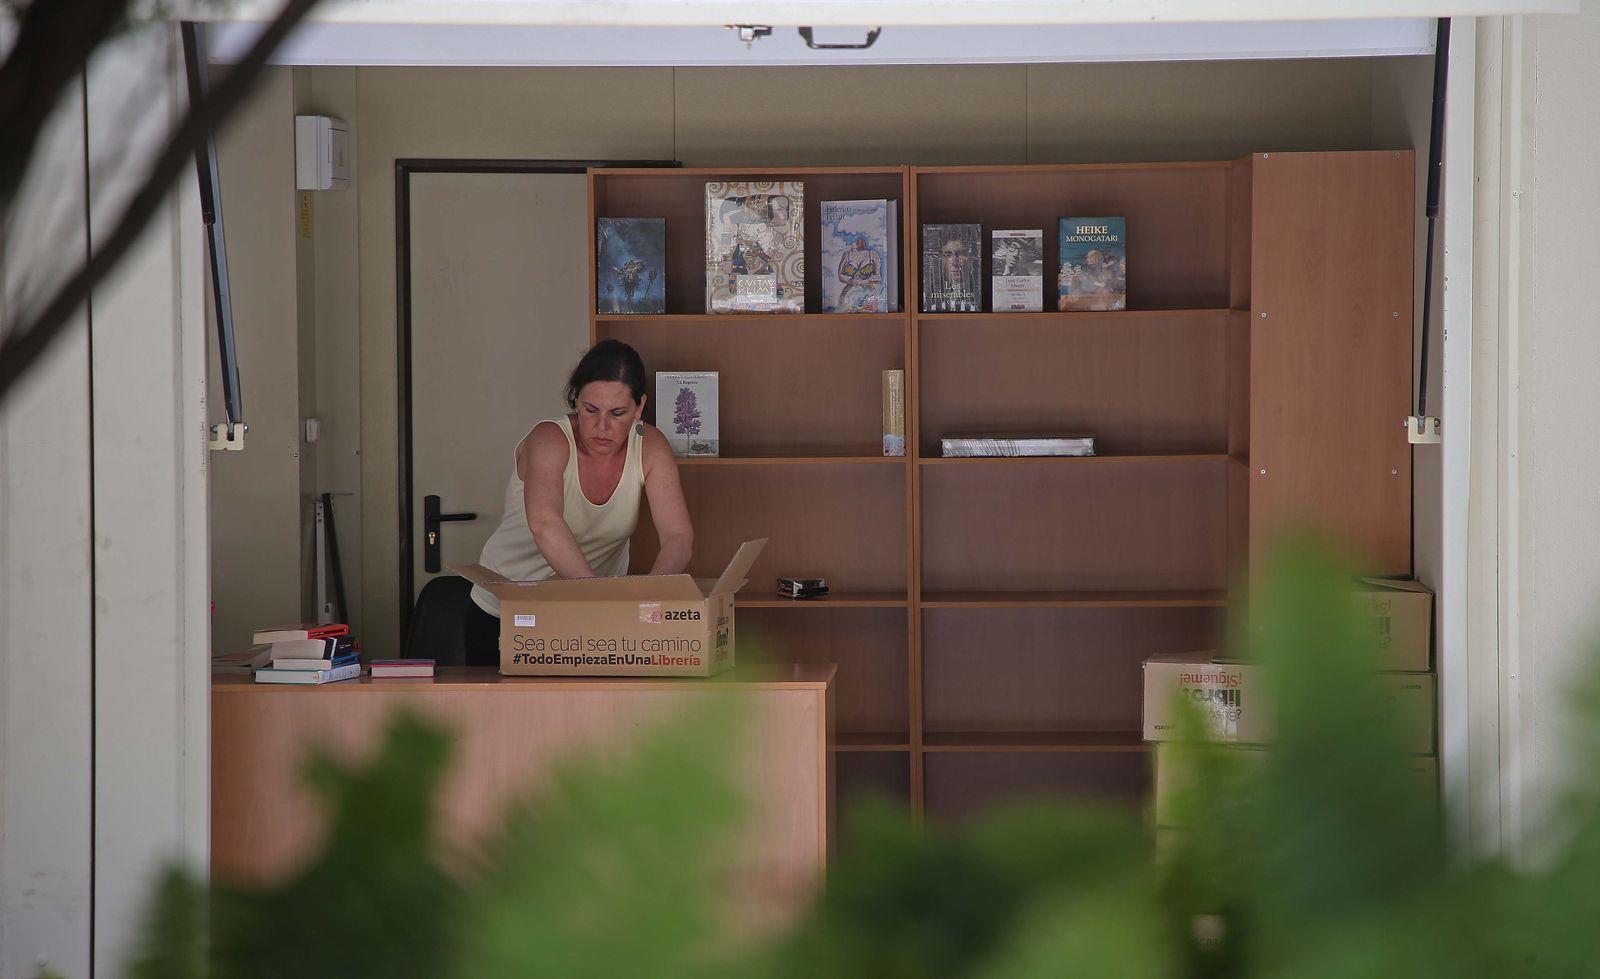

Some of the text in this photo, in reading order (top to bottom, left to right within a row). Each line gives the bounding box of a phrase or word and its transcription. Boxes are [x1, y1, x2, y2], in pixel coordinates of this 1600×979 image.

[1076, 225, 1108, 235] HEIKE
[945, 281, 960, 289] Los
[738, 287, 776, 295] KLIMT
[665, 609, 701, 620] azeta
[513, 634, 702, 652] Sea cual sea tu camino
[513, 654, 701, 667] #TodoEmpiezaEnUnaLibrería
[1180, 671, 1242, 688] ¡Sígueme!
